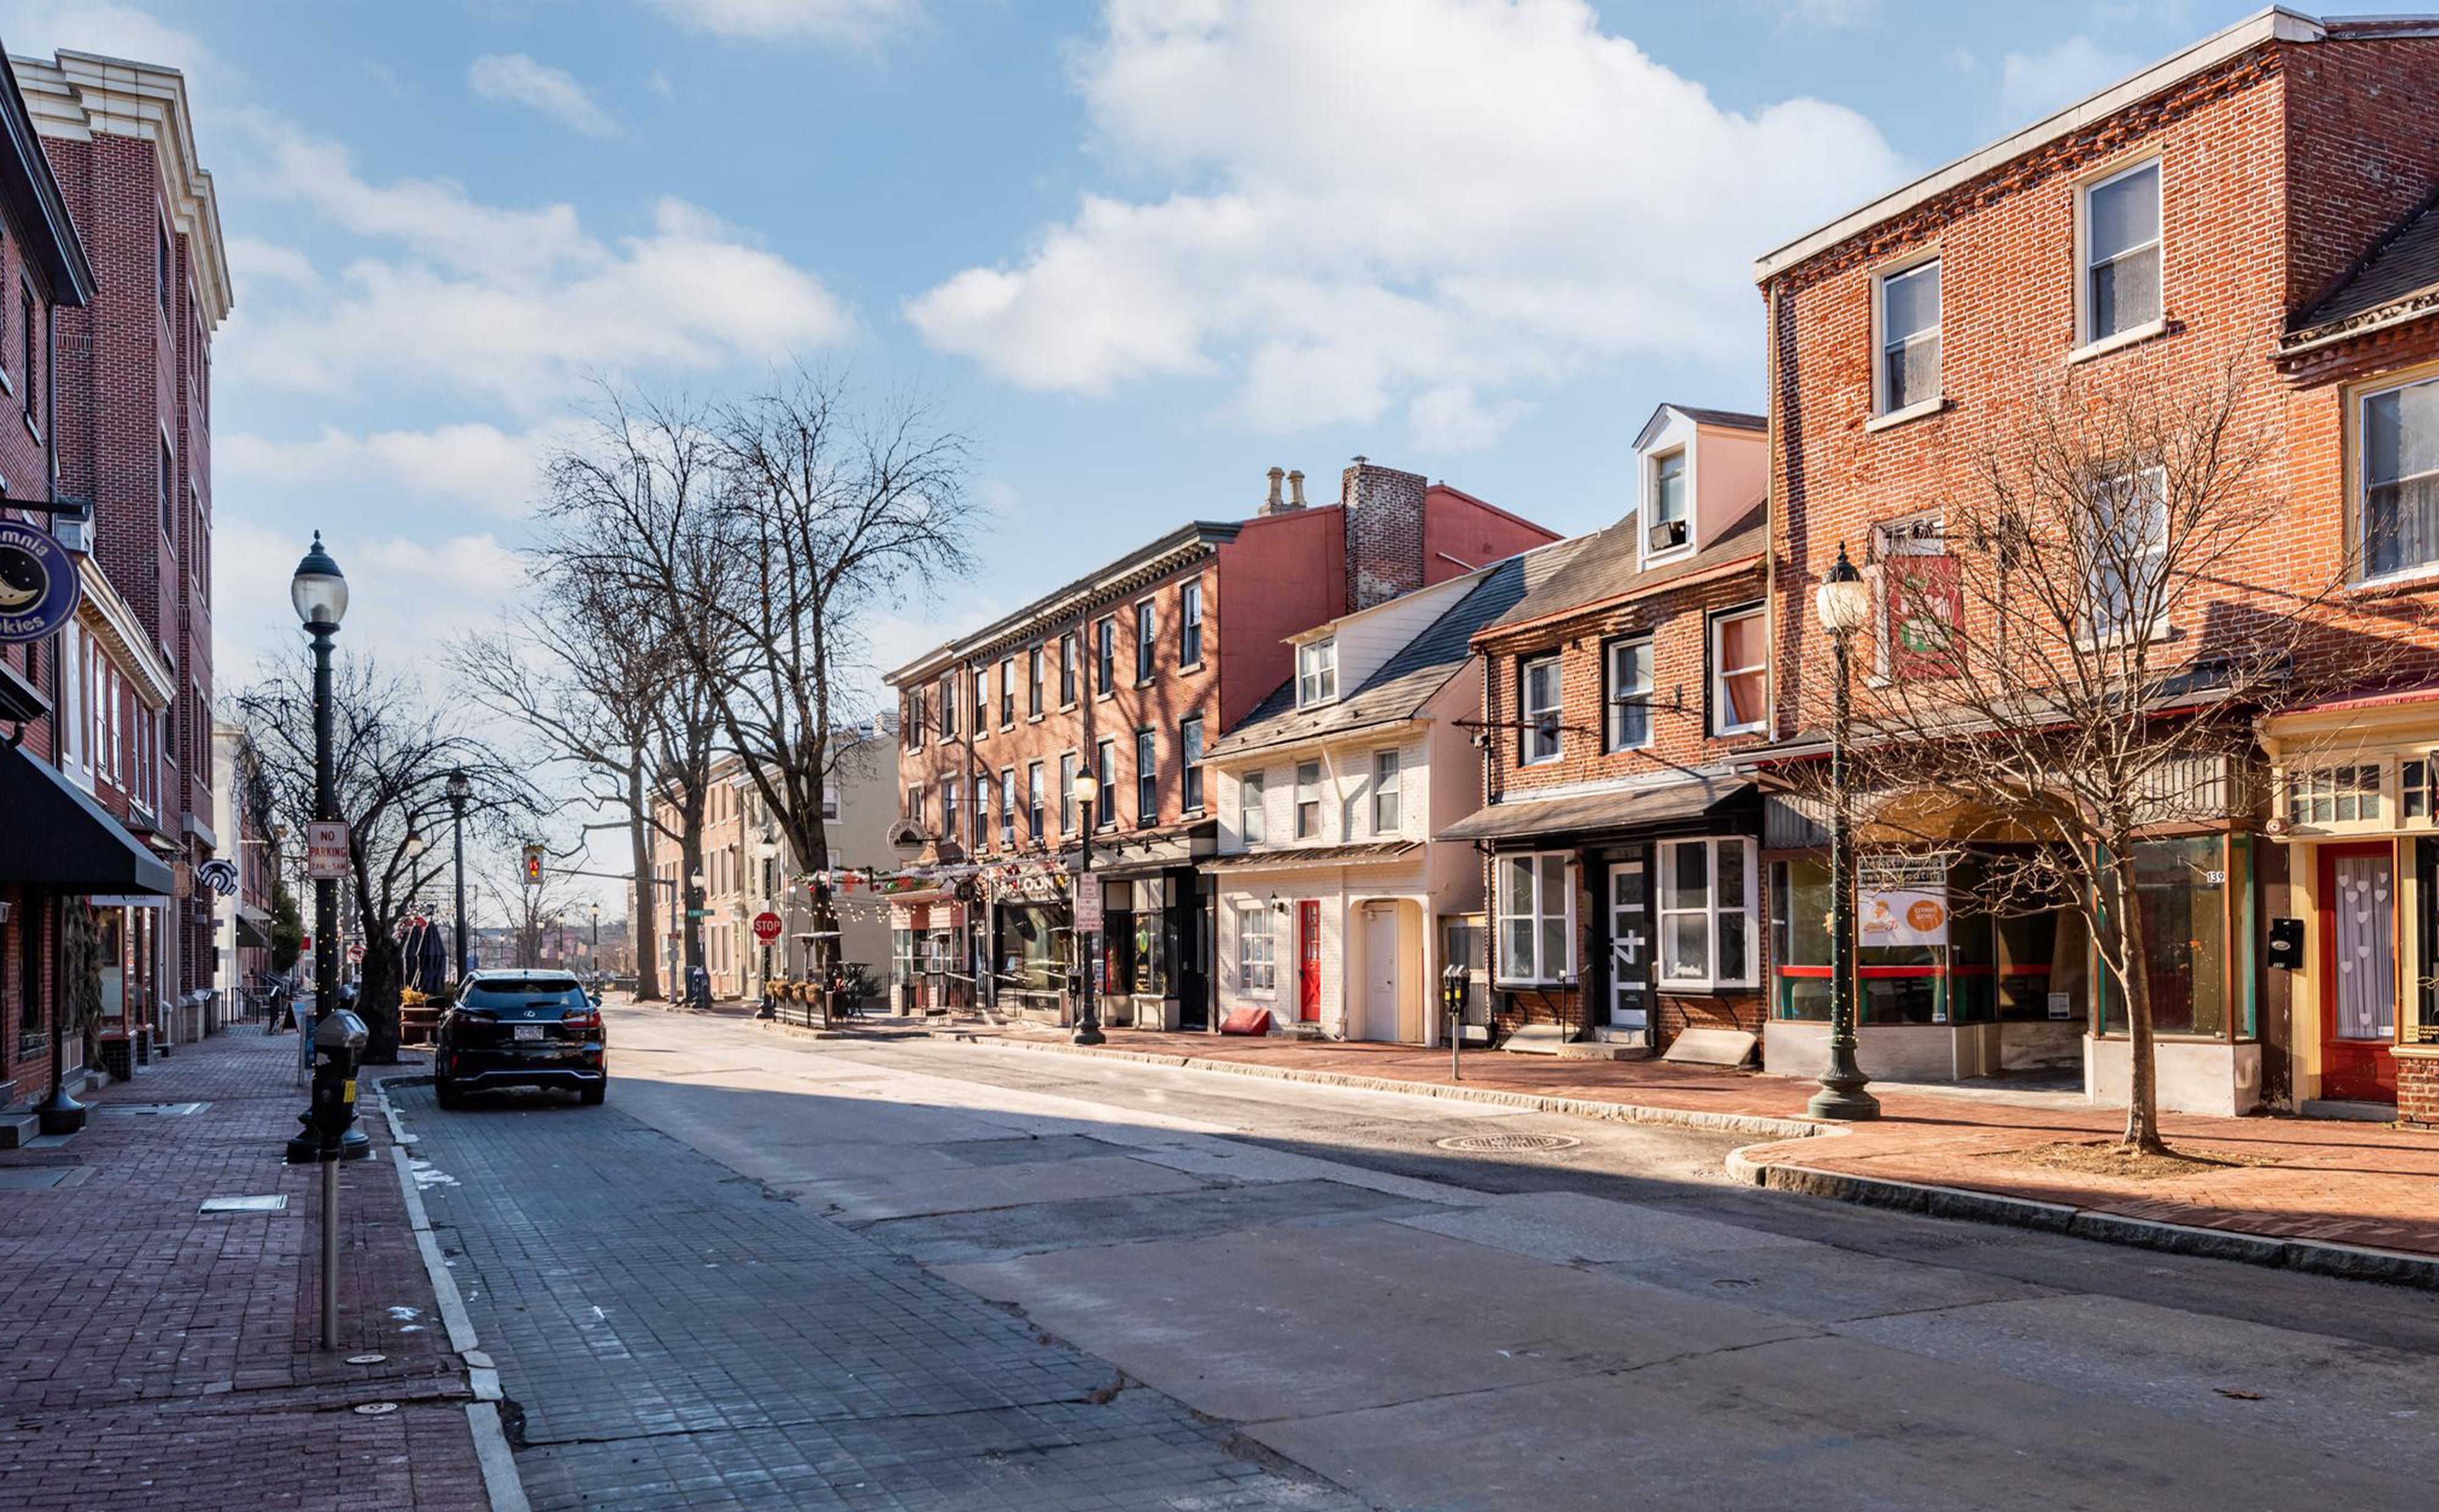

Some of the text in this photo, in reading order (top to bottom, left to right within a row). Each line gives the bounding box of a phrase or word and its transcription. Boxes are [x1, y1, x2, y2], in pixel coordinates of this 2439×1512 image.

[0, 530, 49, 557] mnia
[0, 616, 46, 634] kies
[320, 830, 335, 841] NO
[310, 847, 346, 857] PARKING
[2207, 872, 2224, 882] 139
[755, 921, 781, 932] STOP
